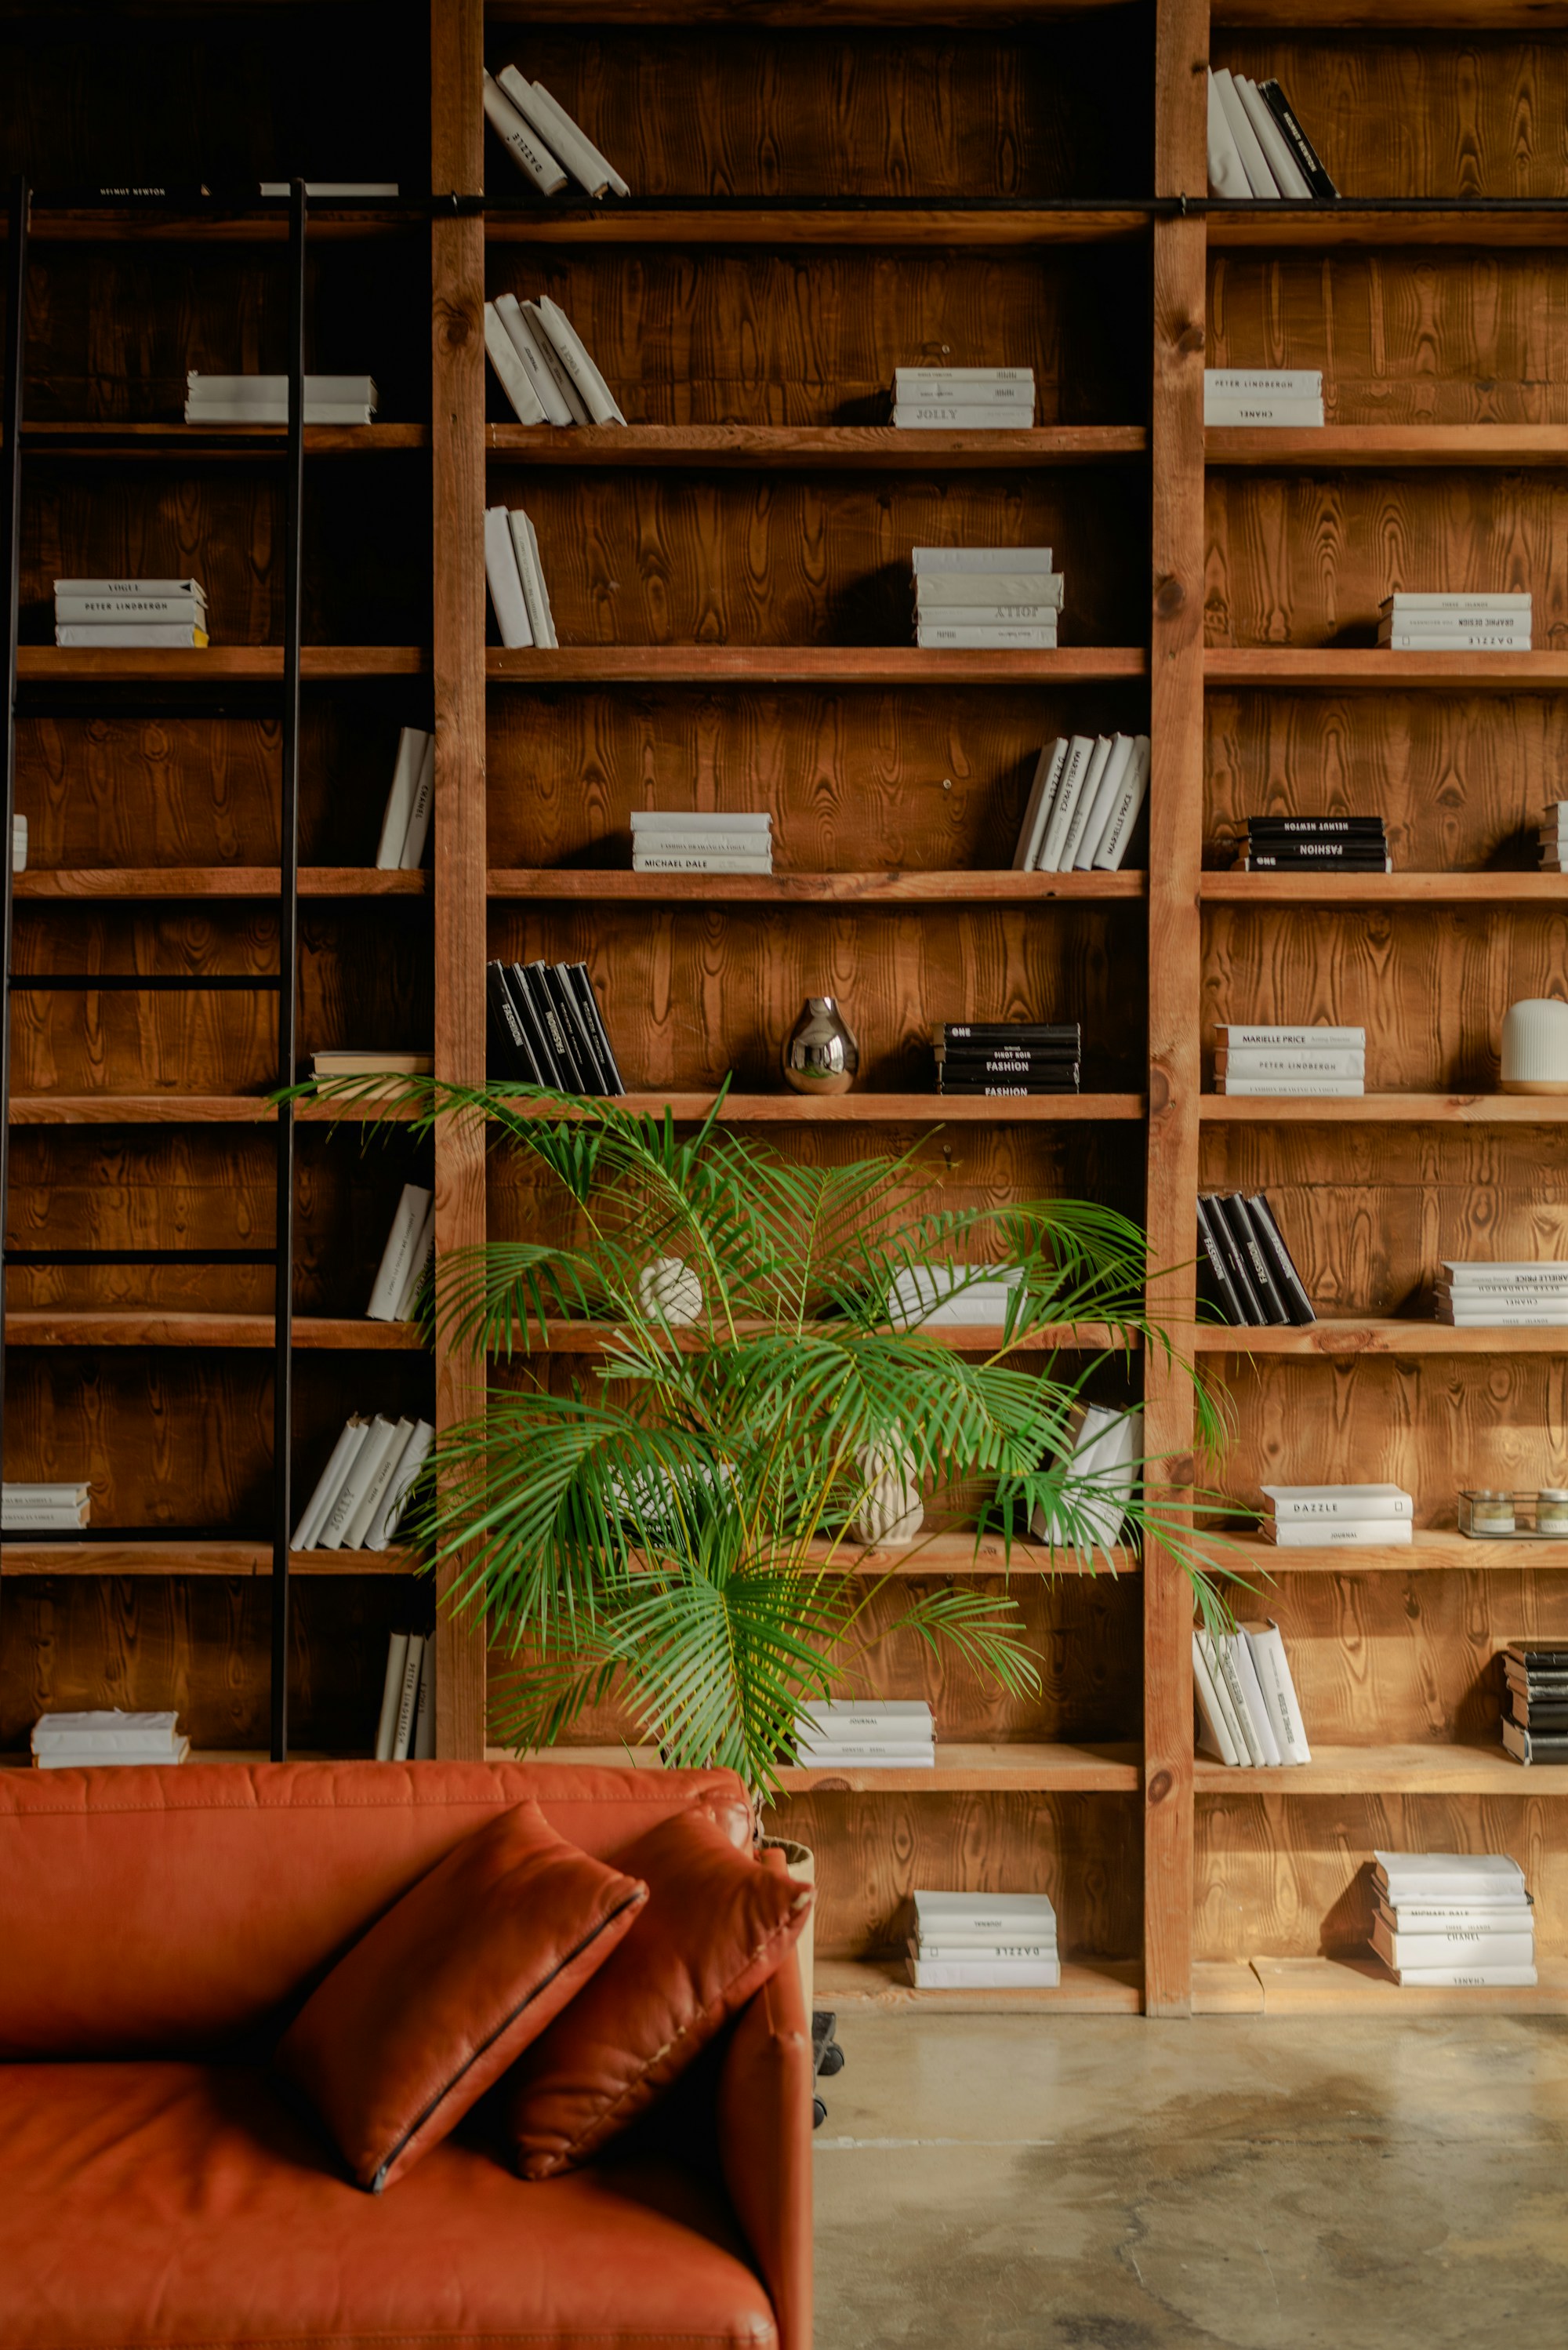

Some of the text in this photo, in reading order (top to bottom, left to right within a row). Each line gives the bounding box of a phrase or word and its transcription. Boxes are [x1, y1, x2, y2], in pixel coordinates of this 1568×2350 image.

[511, 132, 543, 173] DAZZLE
[1215, 380, 1293, 388] PETER LINDBERGH
[916, 409, 957, 420] JOLLY
[85, 602, 168, 611] PETER LINDBERGH
[995, 606, 1038, 618] JOLLY
[1048, 756, 1065, 800] DAZZLE
[1059, 749, 1082, 812] MARIELLE PRICE
[416, 784, 429, 819] CHANEL
[1107, 793, 1133, 855] MARIELLE PRICE
[1284, 823, 1348, 831] HELMUT NEWTON
[1300, 844, 1343, 855] FASHION
[644, 859, 682, 868] MICHAEL
[686, 859, 707, 868] DALE
[502, 1003, 524, 1047] FASHION
[545, 1011, 565, 1055] FASHION
[951, 1027, 971, 1037] ONE
[1242, 1035, 1281, 1044] MARIELLE
[1283, 1035, 1306, 1044] PRICE
[986, 1061, 1029, 1071] FASHION
[1288, 1062, 1336, 1070] LINDBERGH
[985, 1088, 1028, 1097] FASHION
[1203, 1237, 1225, 1280] FASHION
[1247, 1240, 1268, 1284] FASHION
[1271, 1235, 1293, 1279] FASHION
[331, 1487, 355, 1531] JOLLY
[1294, 1503, 1338, 1513] DAZZLE
[397, 1662, 416, 1744] PETER LINDBERGH
[1447, 1933, 1480, 1941] CHANEL
[996, 1947, 1040, 1956] DAZZLE
